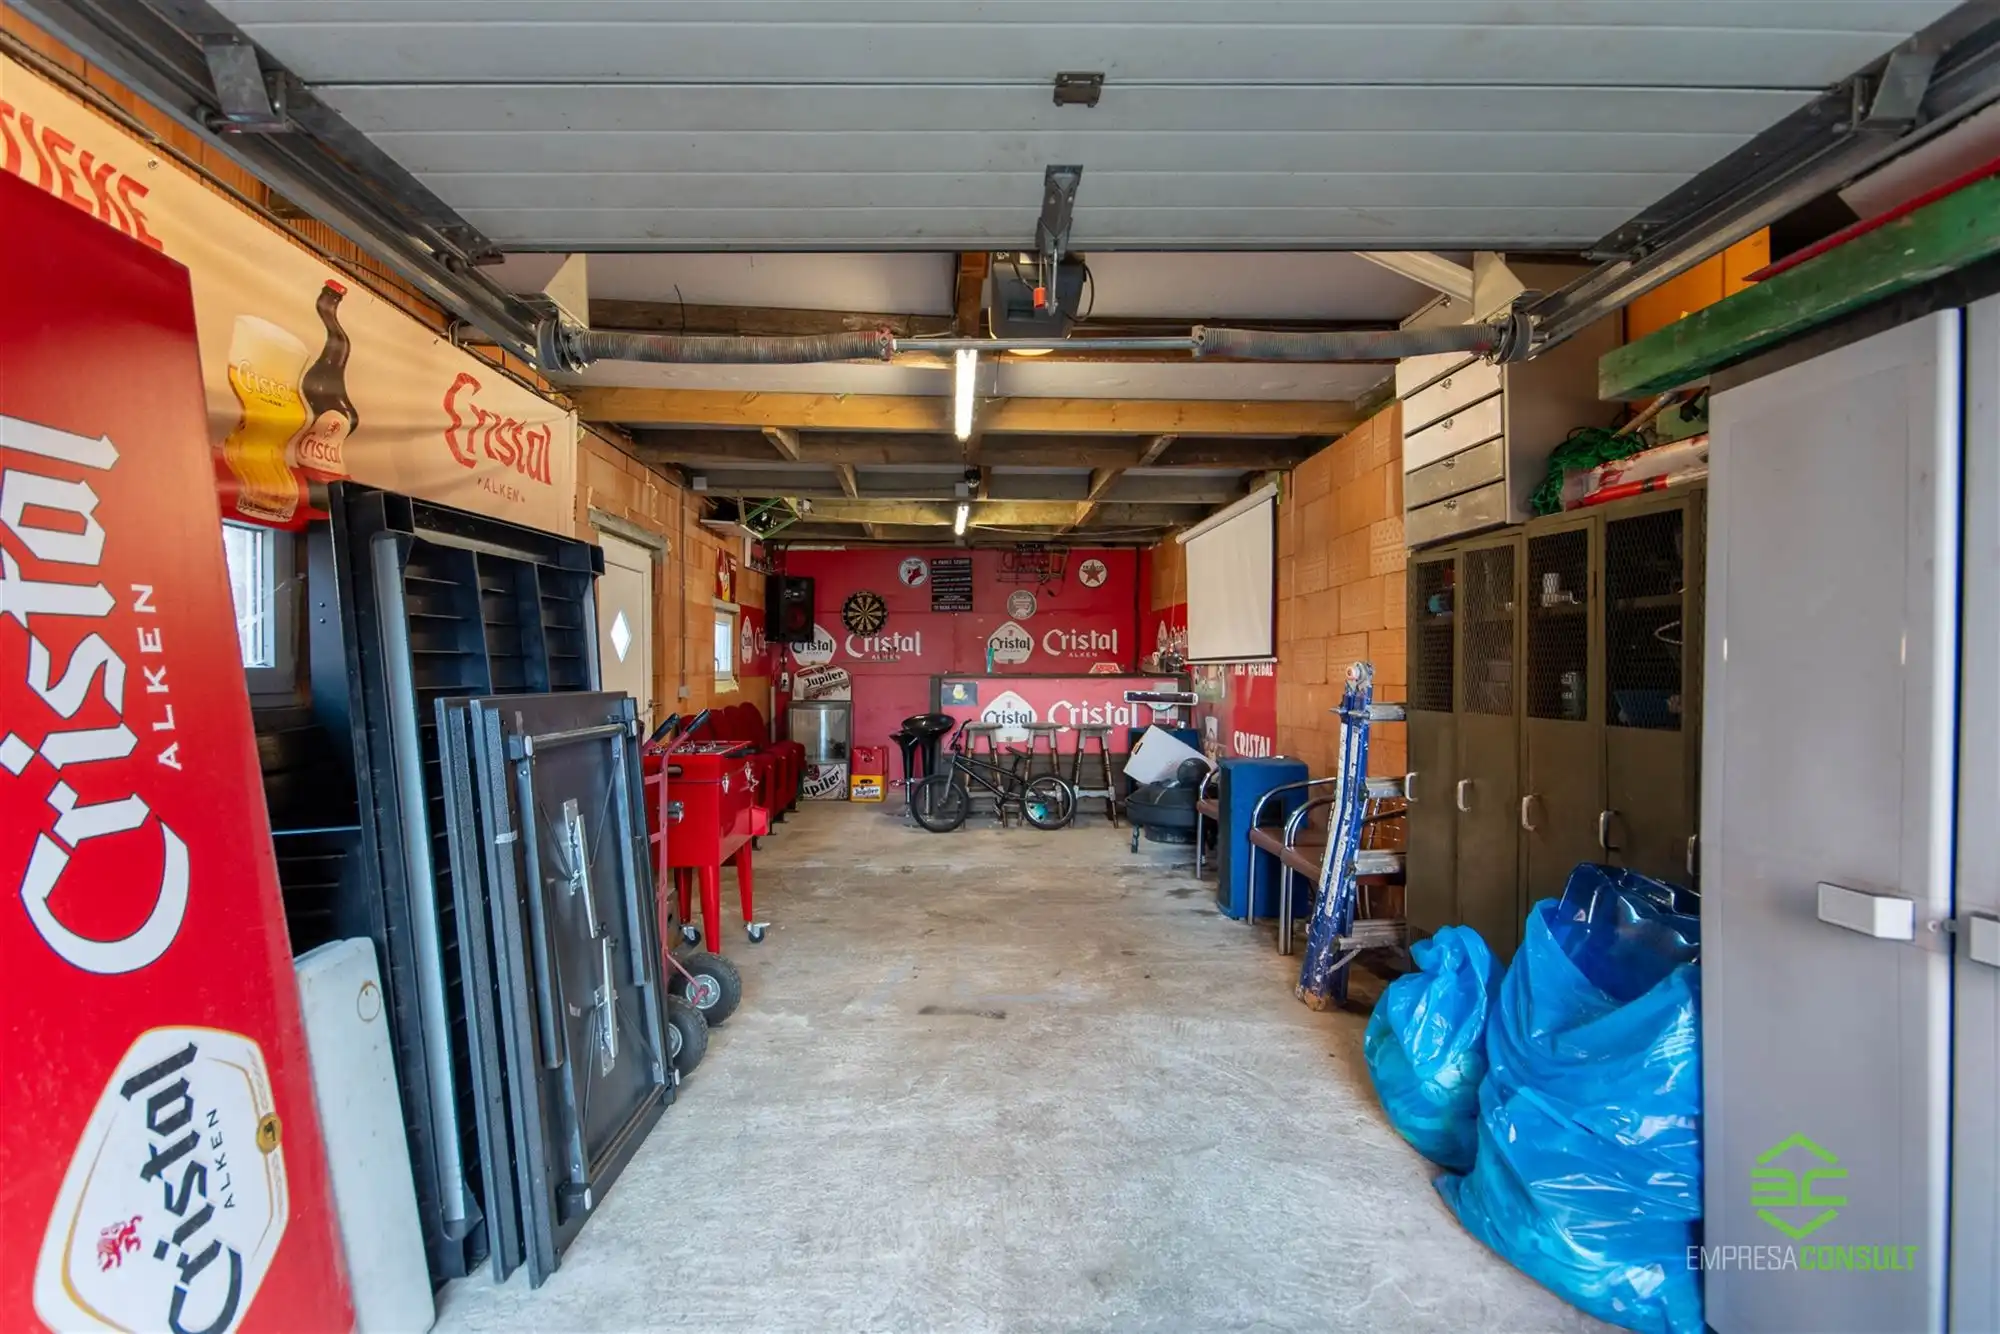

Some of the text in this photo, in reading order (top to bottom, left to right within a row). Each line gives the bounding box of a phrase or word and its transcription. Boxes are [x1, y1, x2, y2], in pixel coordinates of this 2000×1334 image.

[443, 372, 552, 485] Cristal
[483, 481, 521, 501] ALKEN
[844, 630, 922, 658] Cristal
[989, 636, 1031, 652] Cristal
[1042, 628, 1118, 656] Cristal
[131, 583, 182, 771] ALKEN
[804, 670, 845, 688] Jupiler
[0, 415, 190, 974] Cristal
[1047, 699, 1137, 733] Cristal
[803, 770, 841, 797] upiler
[206, 1108, 236, 1209] ALKEN
[120, 1042, 242, 1334] Cristal
